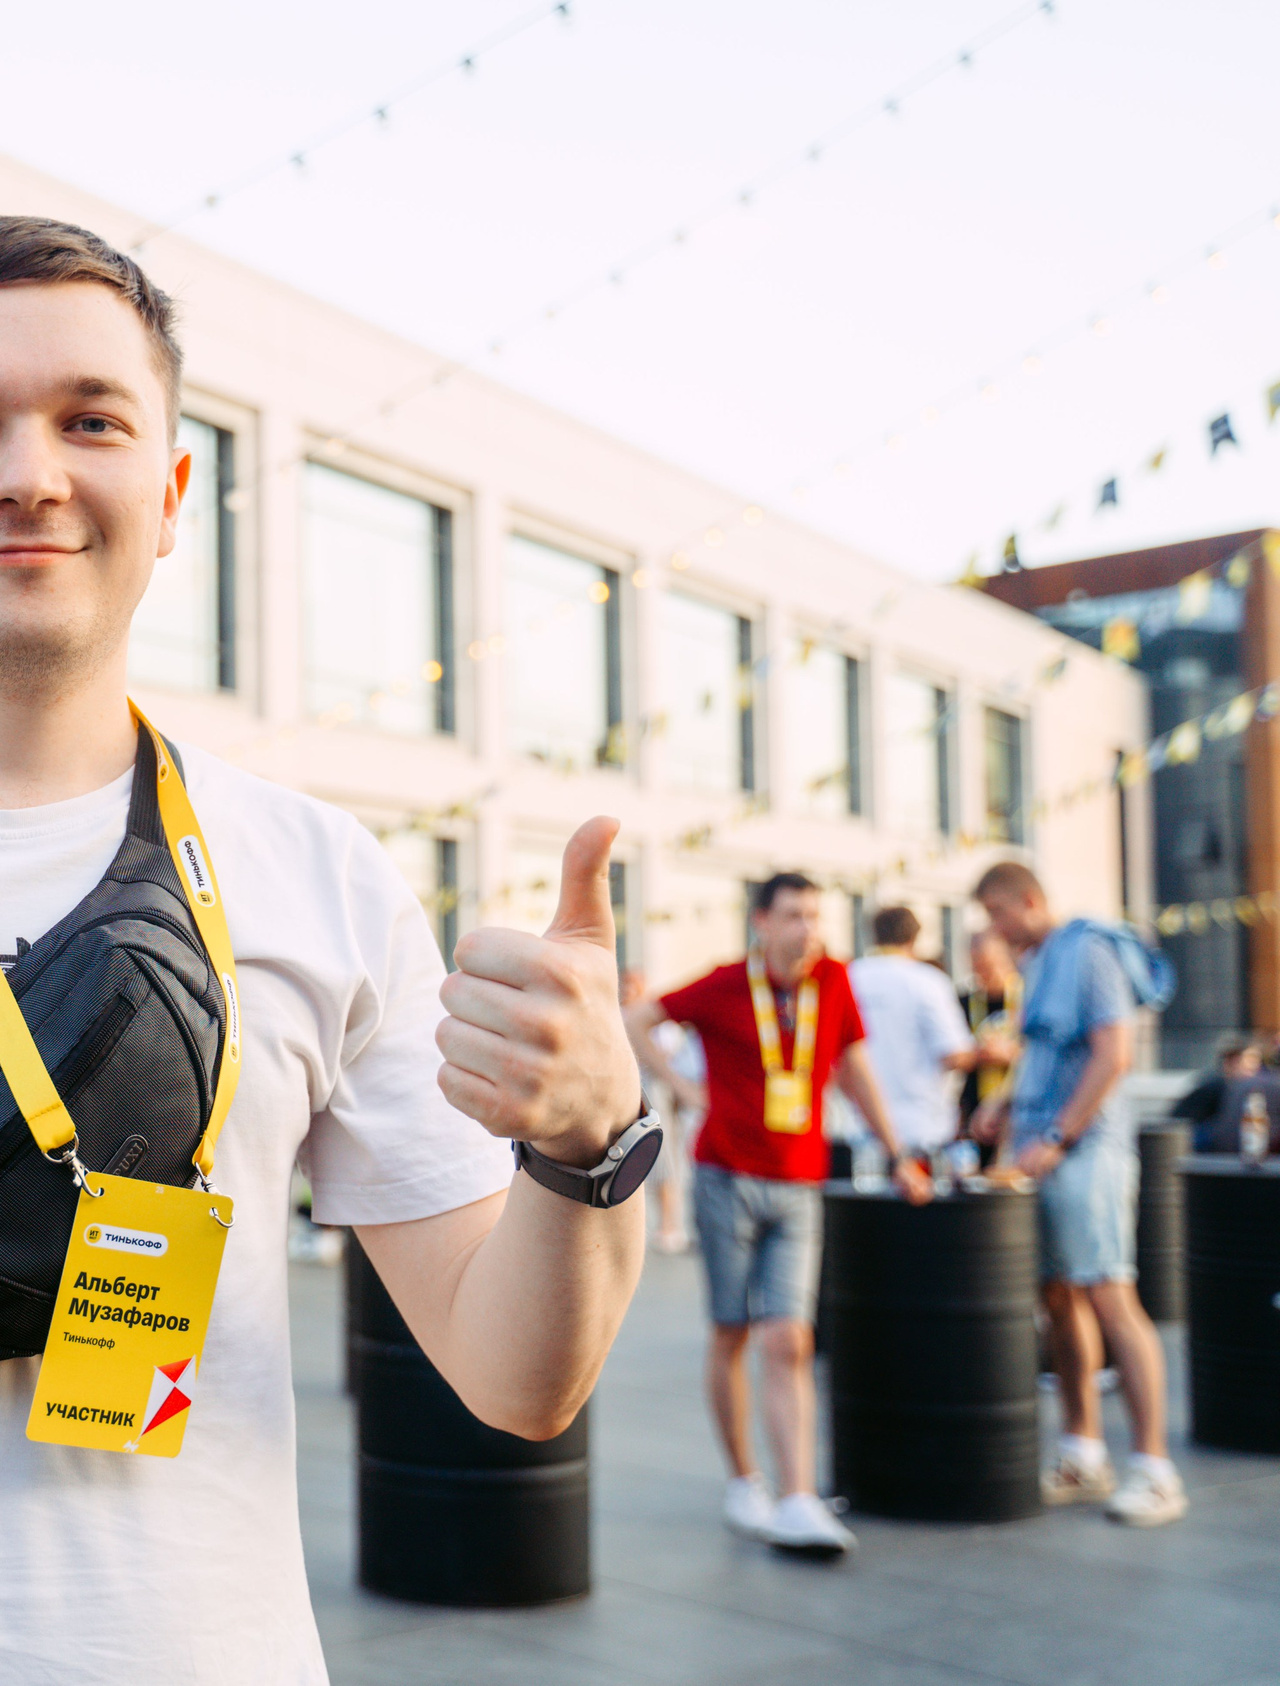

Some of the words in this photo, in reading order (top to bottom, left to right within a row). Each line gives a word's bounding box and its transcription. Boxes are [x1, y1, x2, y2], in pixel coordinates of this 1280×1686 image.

[184, 840, 205, 888] ТИНЬКОФФ
[105, 1233, 162, 1249] ТИНЬКОФФ
[73, 1271, 160, 1303] Альберт
[68, 1297, 190, 1332] Музафаров
[63, 1332, 116, 1350] Тинькофф
[46, 1402, 136, 1427] УЧАСТНИК
